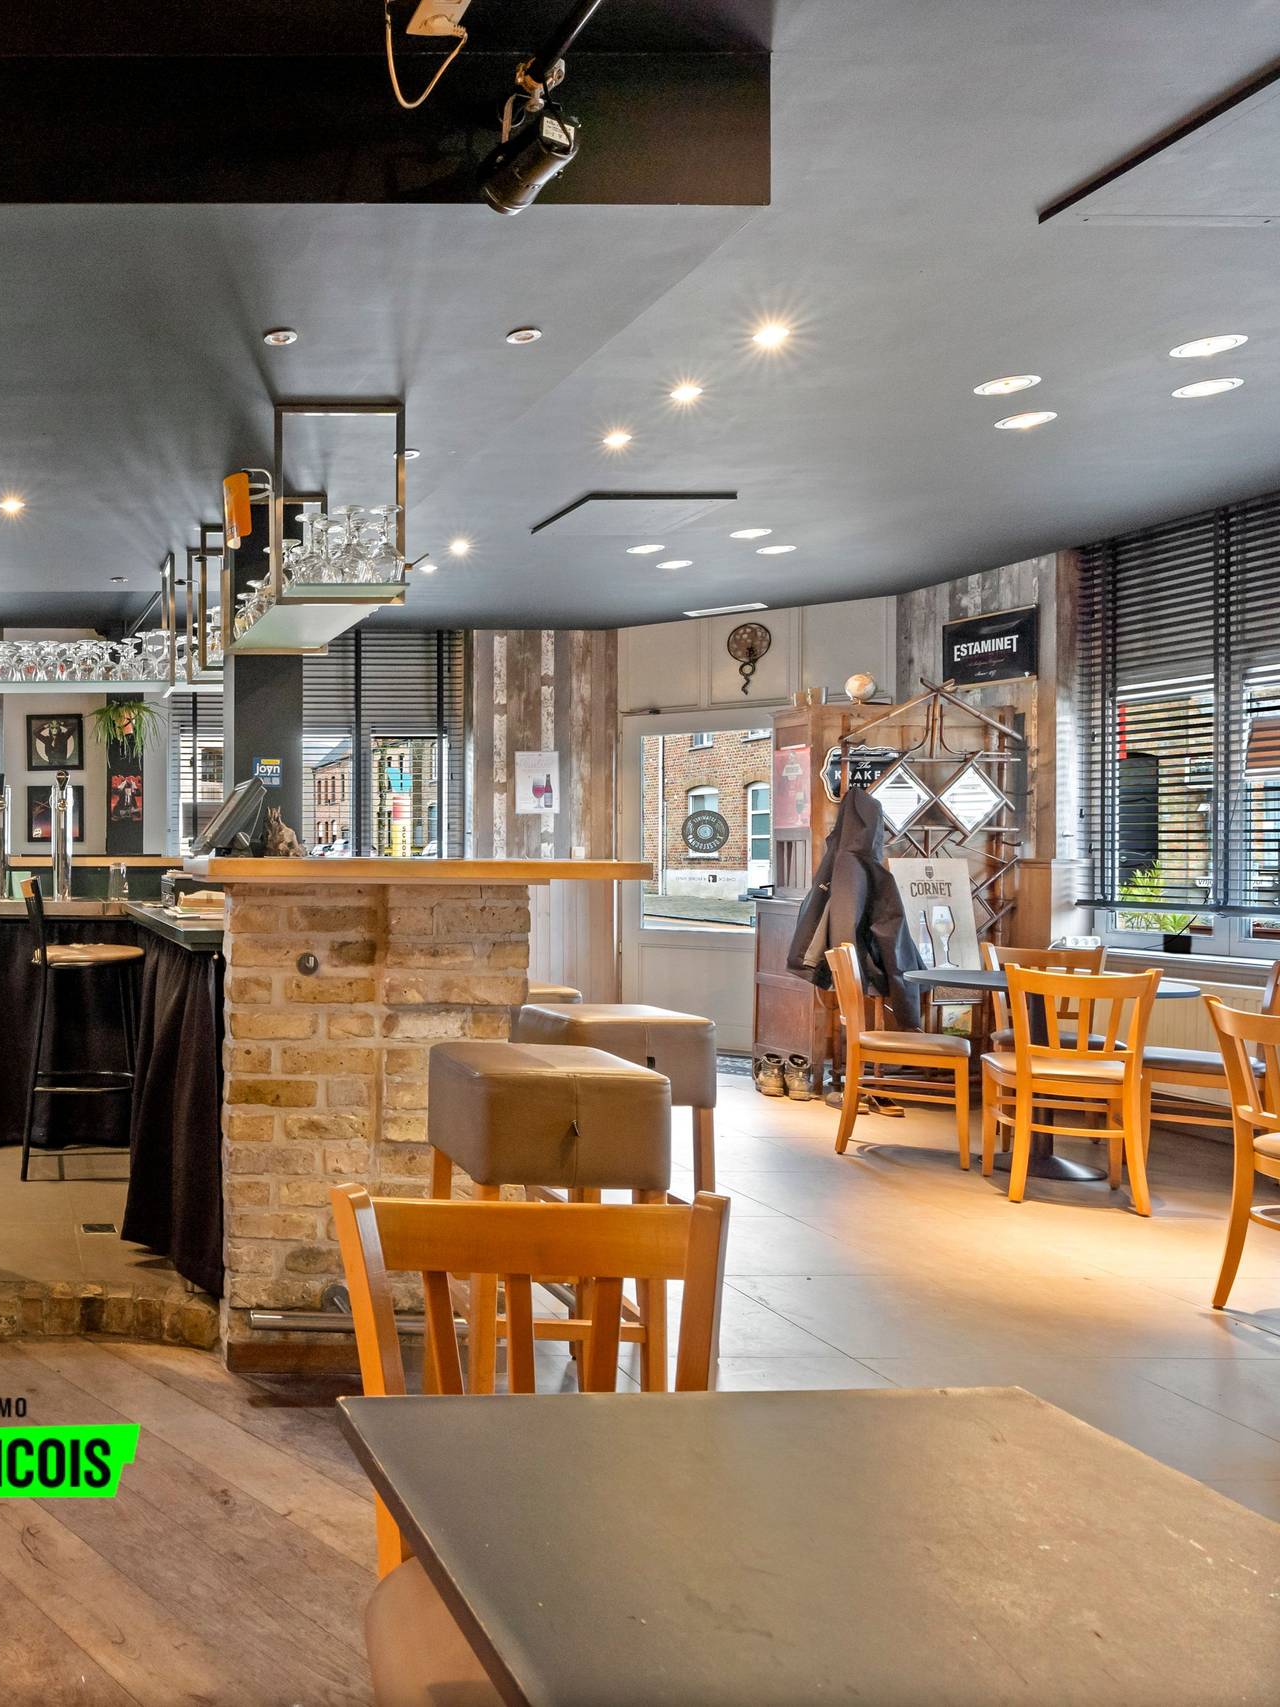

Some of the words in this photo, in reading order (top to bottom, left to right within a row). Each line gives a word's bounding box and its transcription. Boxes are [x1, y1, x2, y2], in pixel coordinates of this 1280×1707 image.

[954, 635, 1019, 662] ESTAMINET
[254, 763, 281, 776] joyn
[834, 770, 881, 780] KRAKE
[910, 882, 952, 897] CORNET
